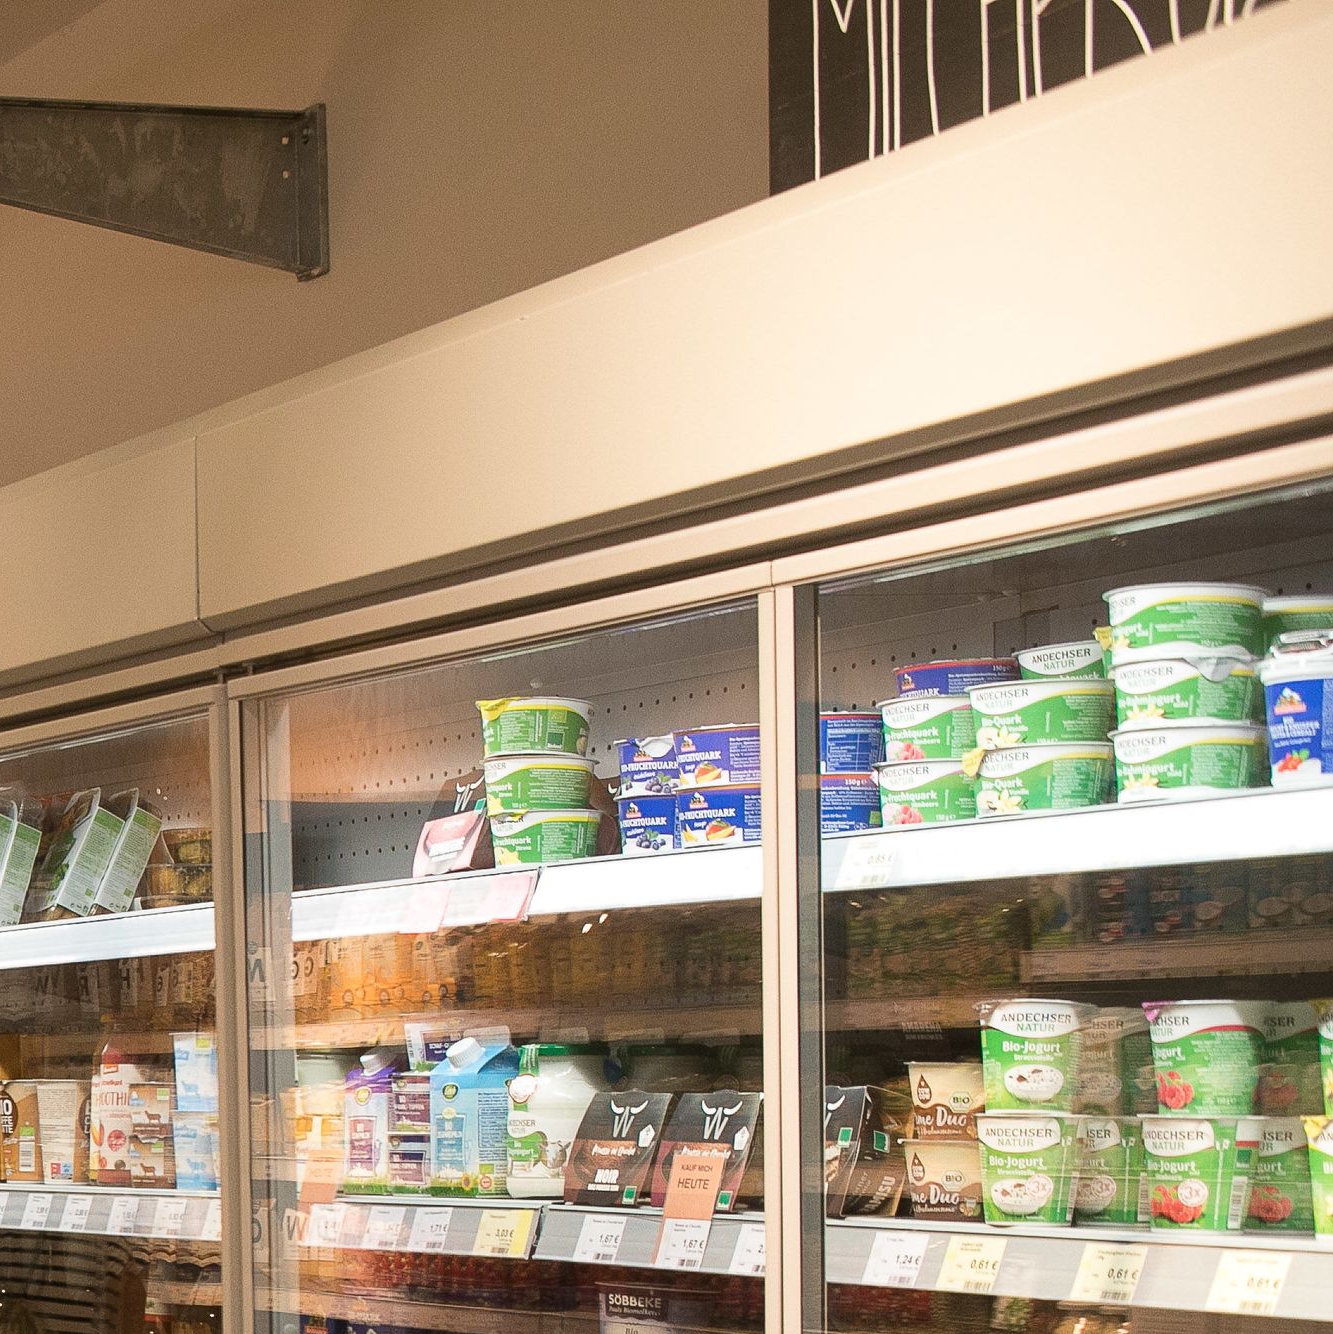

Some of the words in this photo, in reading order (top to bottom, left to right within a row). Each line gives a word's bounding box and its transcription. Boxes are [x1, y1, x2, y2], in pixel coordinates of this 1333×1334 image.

[1032, 648, 1091, 664] ANDECHSER
[1043, 659, 1075, 671] NATUR
[1001, 1012, 1072, 1024] ANDECHSER
[1016, 1022, 1056, 1032] NATUR
[1002, 1040, 1061, 1055] Bio-Jogurt
[936, 1107, 967, 1127] Duo
[985, 1127, 1053, 1139] ANDECHSER
[997, 1137, 1034, 1147] NATUR
[681, 1163, 696, 1172] KAUF
[698, 1164, 713, 1173] MICH
[989, 1155, 1044, 1170] Bio-Jogurt
[677, 1177, 710, 1191] HEUTE
[1032, 1179, 1048, 1193] 3x
[930, 1185, 960, 1205] Duo
[895, 1255, 912, 1266] 1,24
[970, 1260, 989, 1271] 0,61
[1107, 1269, 1127, 1280] 0,61
[608, 1293, 663, 1309] SÖBBEKE
